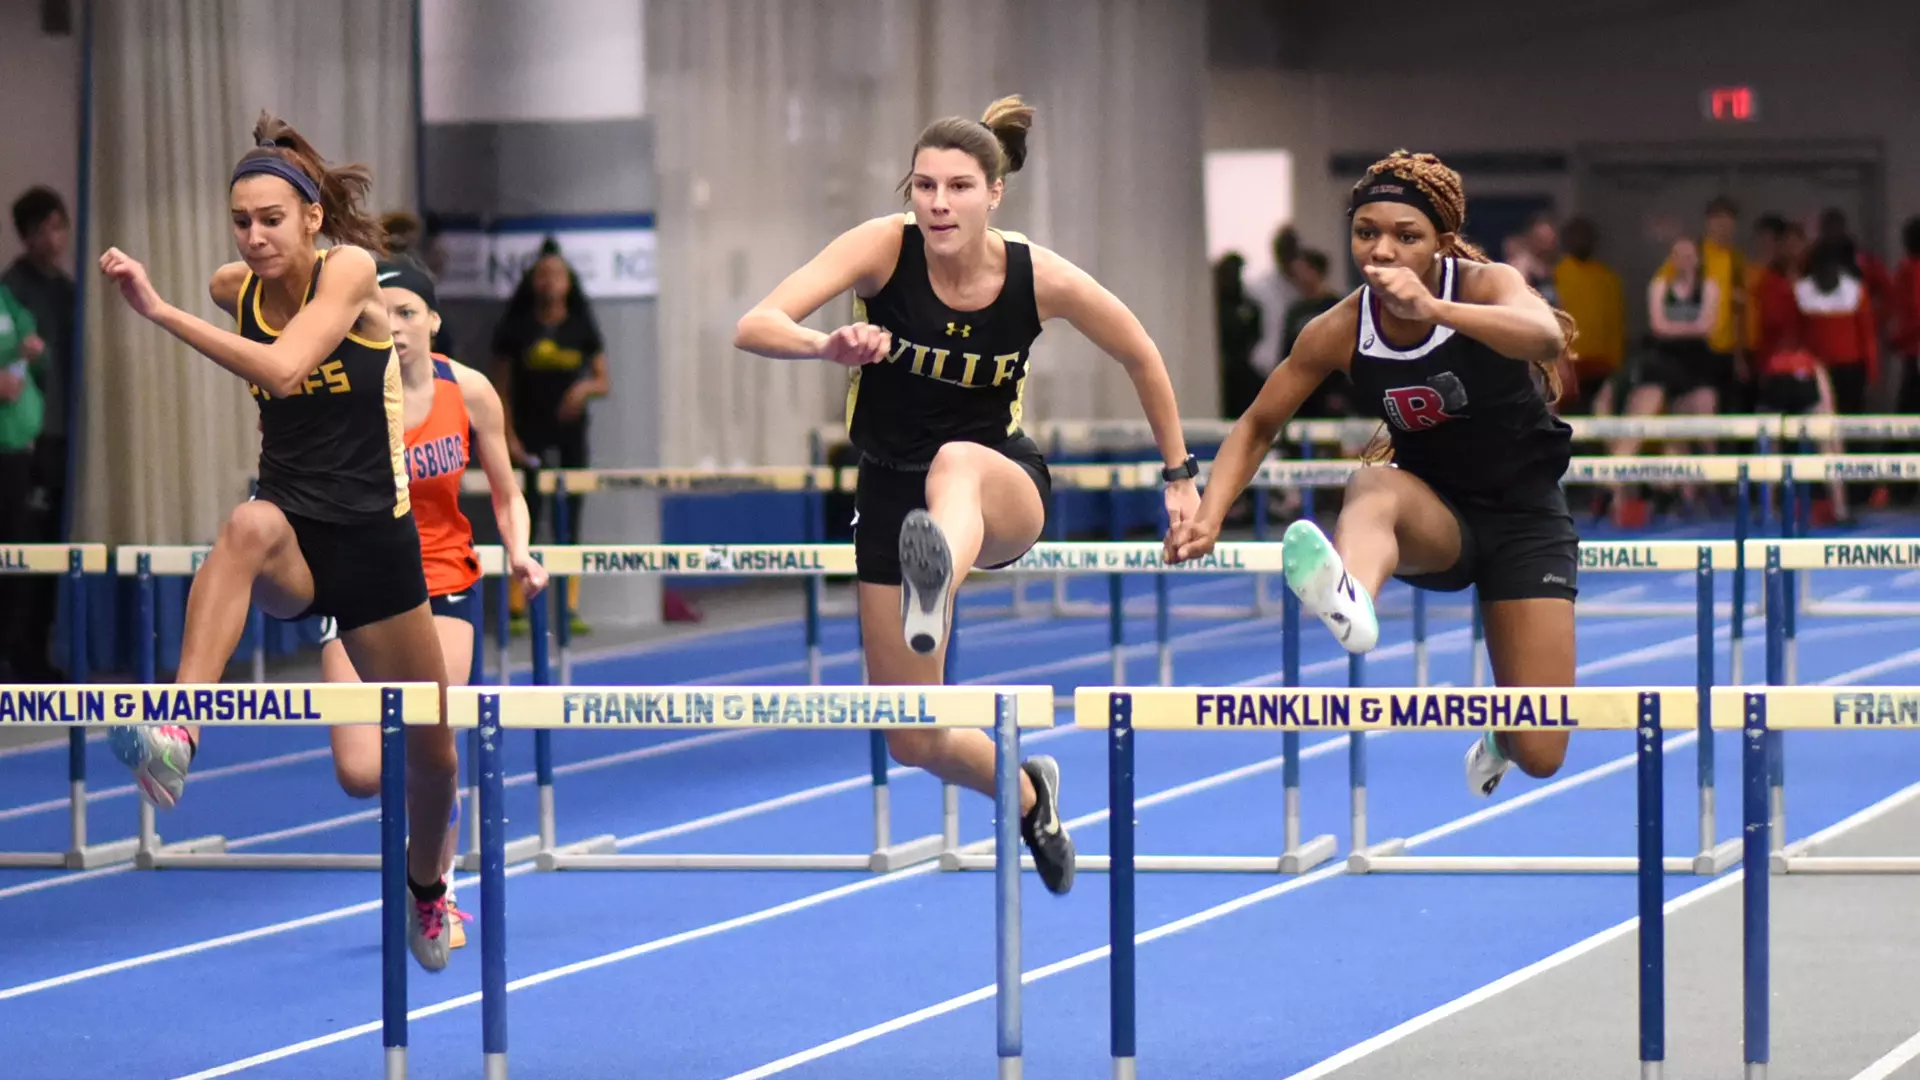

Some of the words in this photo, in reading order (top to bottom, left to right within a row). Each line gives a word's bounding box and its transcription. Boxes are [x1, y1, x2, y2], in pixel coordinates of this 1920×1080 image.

[0, 549, 30, 569] LL
[581, 551, 680, 571] FRANKLIN
[1124, 549, 1245, 568] MAALL
[114, 693, 137, 719] &
[142, 688, 321, 722] MARSHALL
[562, 692, 714, 724] FRANKLIN
[752, 692, 936, 724] MARSHALL
[1195, 694, 1350, 726] FRANKLIN
[1360, 697, 1384, 723] &
[1390, 694, 1578, 726] MARSHALL
